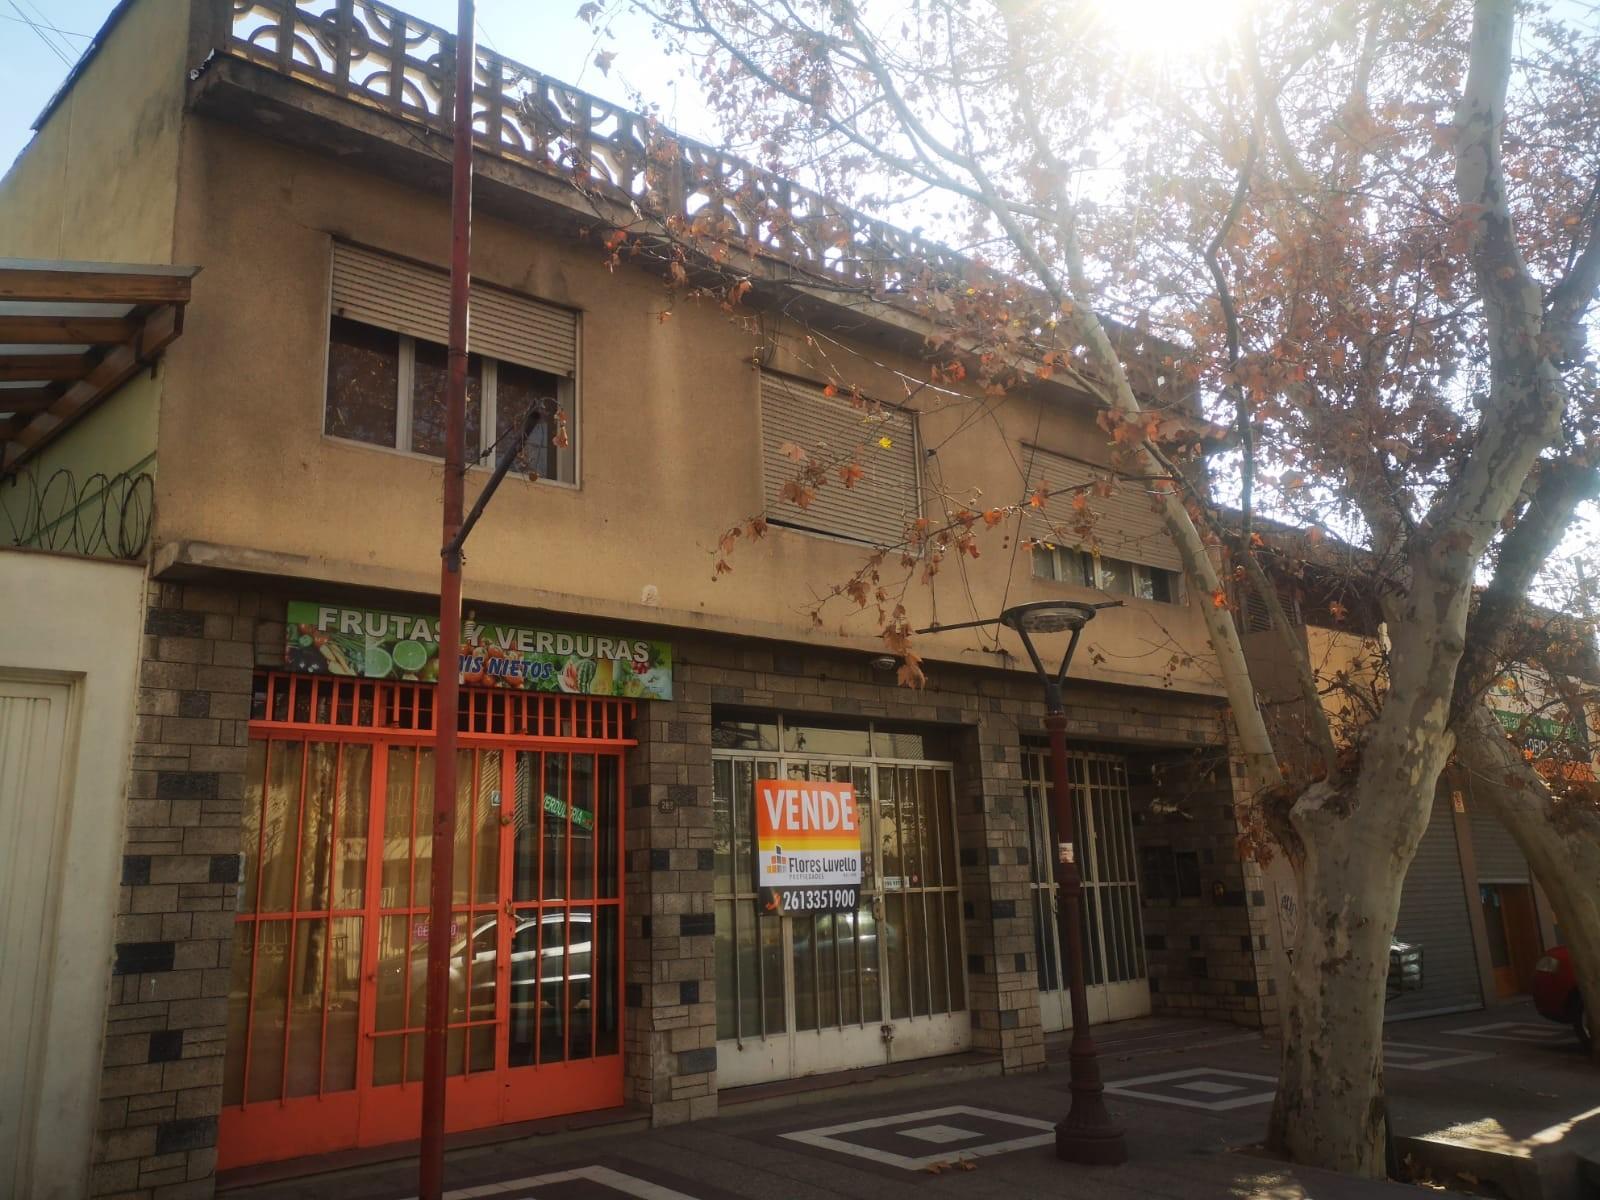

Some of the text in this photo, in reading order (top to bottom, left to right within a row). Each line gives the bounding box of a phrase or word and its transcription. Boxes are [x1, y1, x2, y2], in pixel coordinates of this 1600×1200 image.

[470, 624, 485, 647] Y
[496, 627, 649, 663] VERDURAS
[487, 657, 553, 680] NIETOS
[763, 789, 855, 831] VENDE
[788, 857, 857, 873] Flores Luvello
[783, 889, 855, 911] 2613351900
